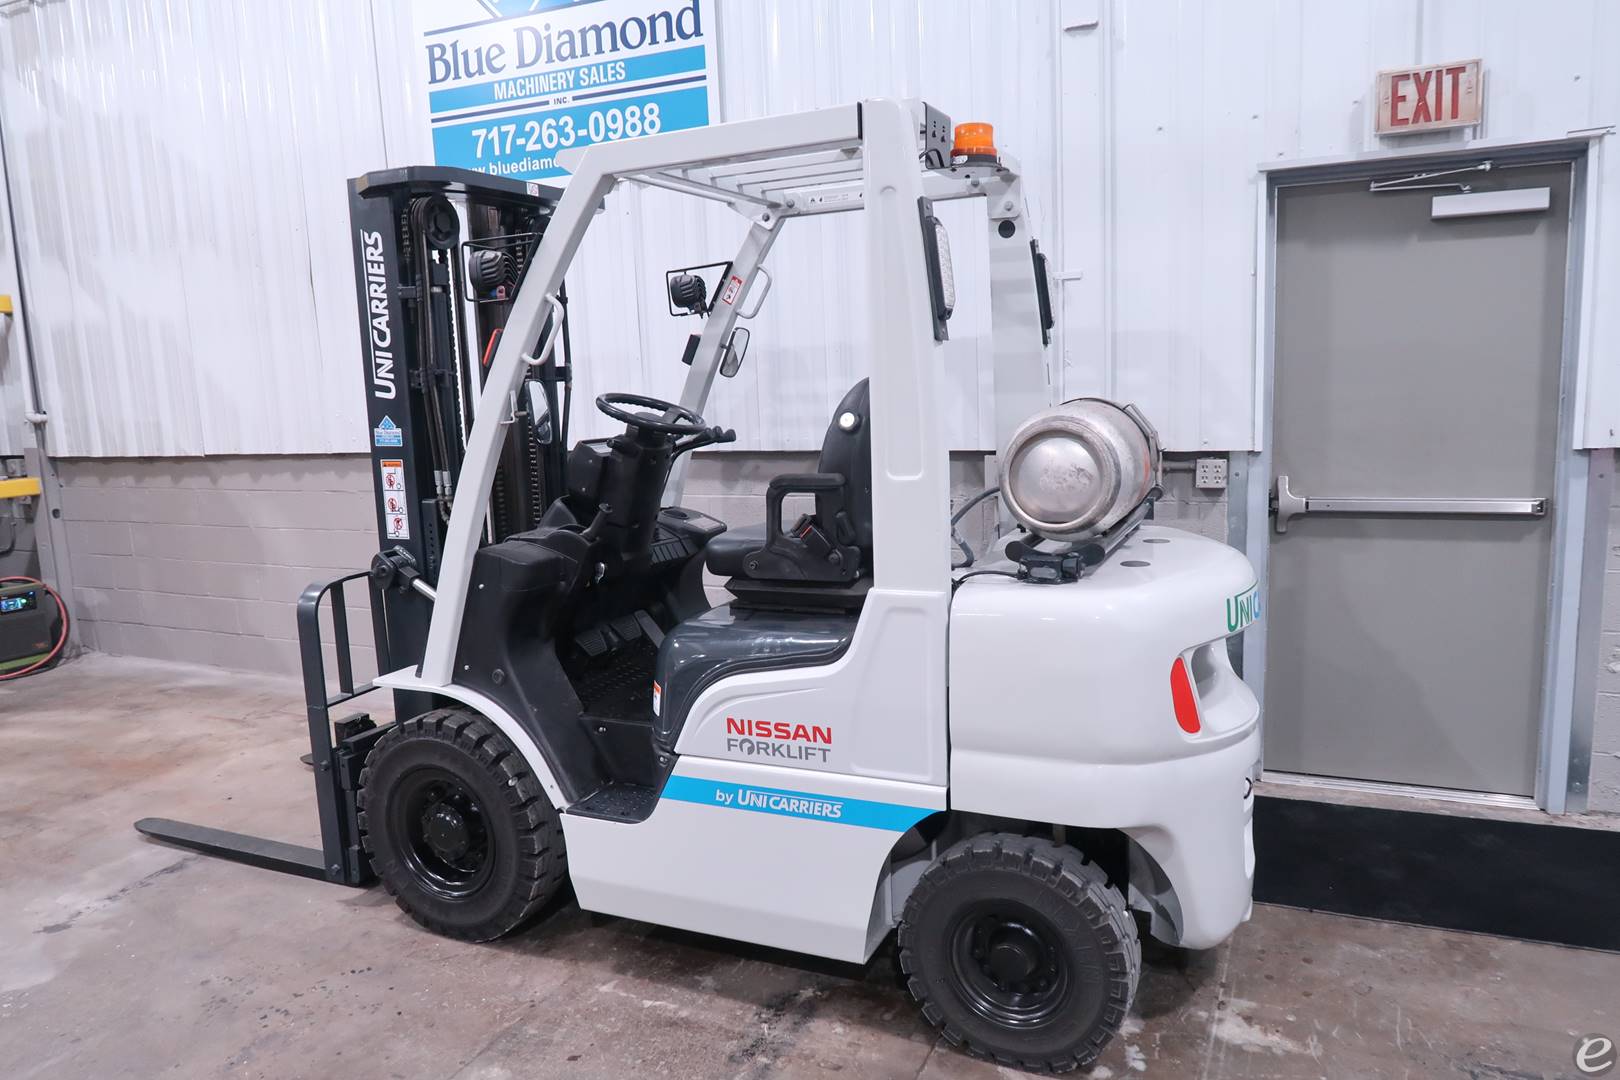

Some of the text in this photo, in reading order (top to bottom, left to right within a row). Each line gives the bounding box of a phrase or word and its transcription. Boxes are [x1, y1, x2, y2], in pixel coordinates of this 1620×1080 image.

[425, 0, 704, 85] Blue Diamond
[494, 61, 626, 101] MACHINERY SALES
[1391, 66, 1466, 127] EXIT
[553, 96, 570, 105] INC.
[471, 102, 661, 159] 717-263-0988
[726, 717, 832, 744] NISSAN
[727, 737, 831, 763] FORKLIFT
[715, 789, 734, 805] by
